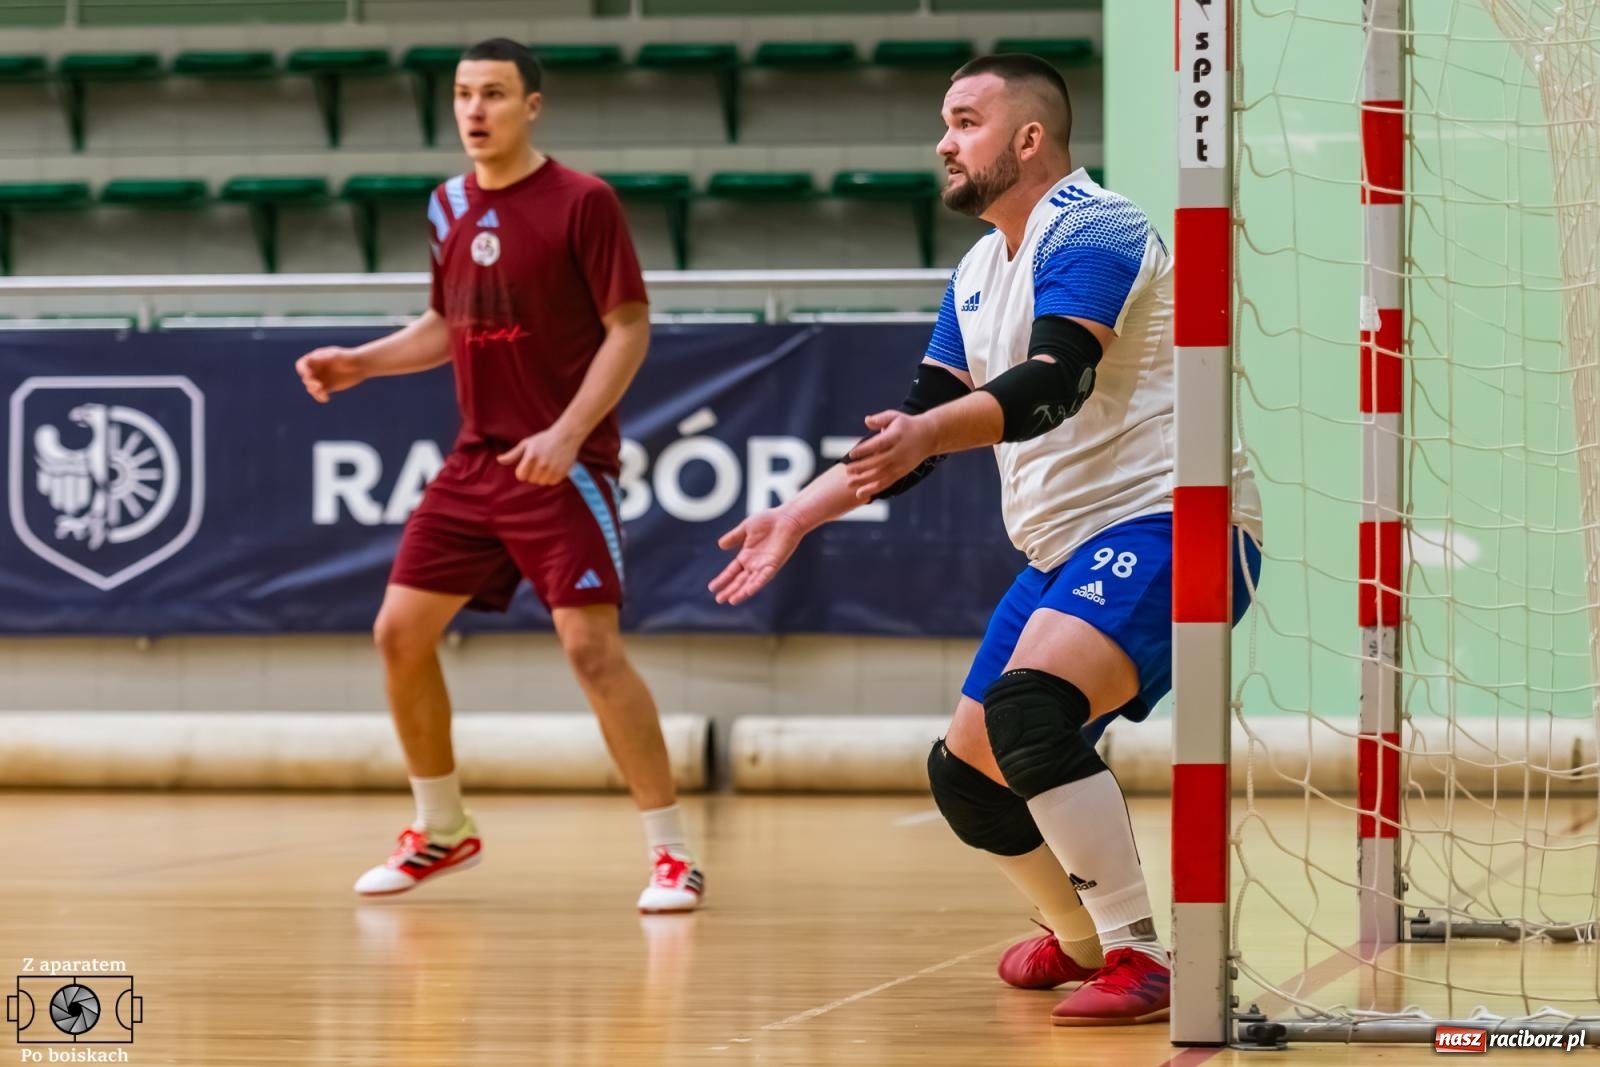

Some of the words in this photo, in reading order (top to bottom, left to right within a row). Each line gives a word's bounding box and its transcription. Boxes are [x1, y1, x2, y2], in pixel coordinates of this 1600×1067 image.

[1193, 32, 1212, 162] sport
[312, 406, 890, 525] RABÓRZ
[1072, 588, 1106, 605] adidas
[1089, 547, 1138, 578] 98
